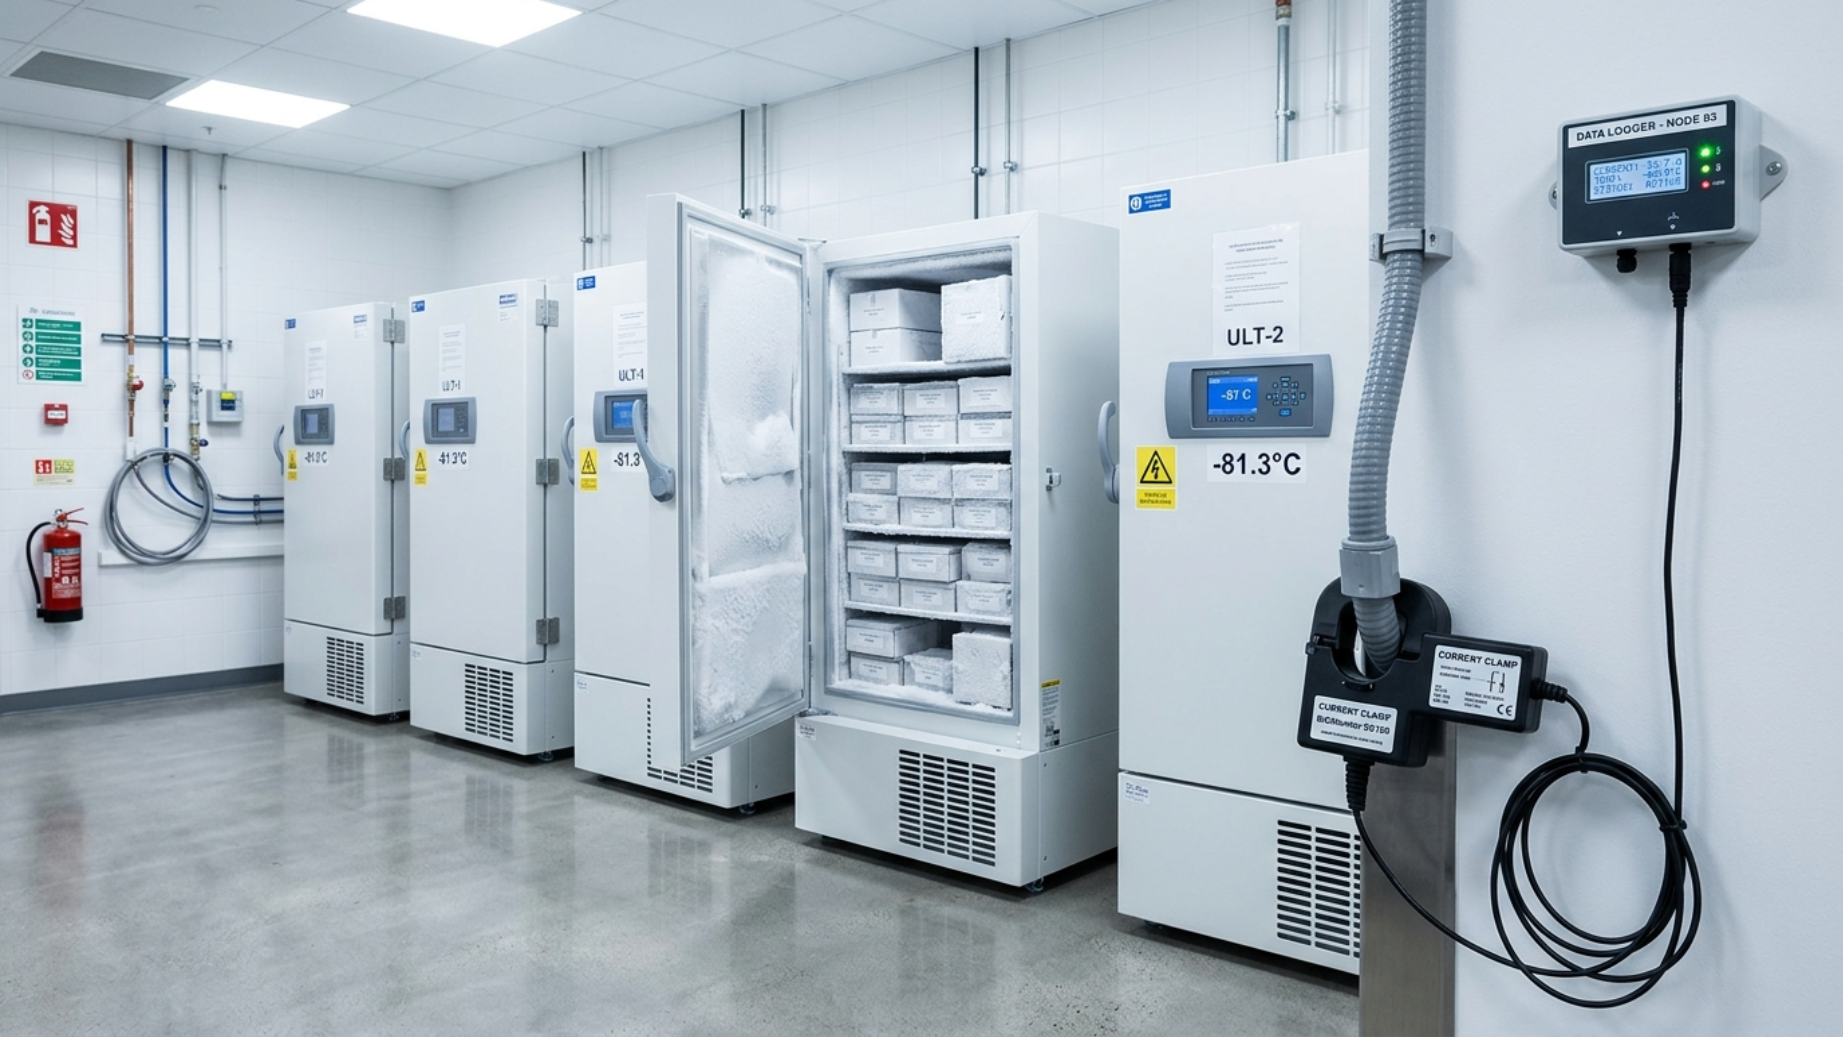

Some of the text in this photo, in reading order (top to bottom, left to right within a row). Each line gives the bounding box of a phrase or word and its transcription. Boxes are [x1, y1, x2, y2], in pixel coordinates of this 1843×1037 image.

[1576, 129, 1605, 141] DATA
[1666, 114, 1700, 128] NODE
[1227, 326, 1284, 346] ULT-2
[1213, 452, 1301, 476] -81.3°C
